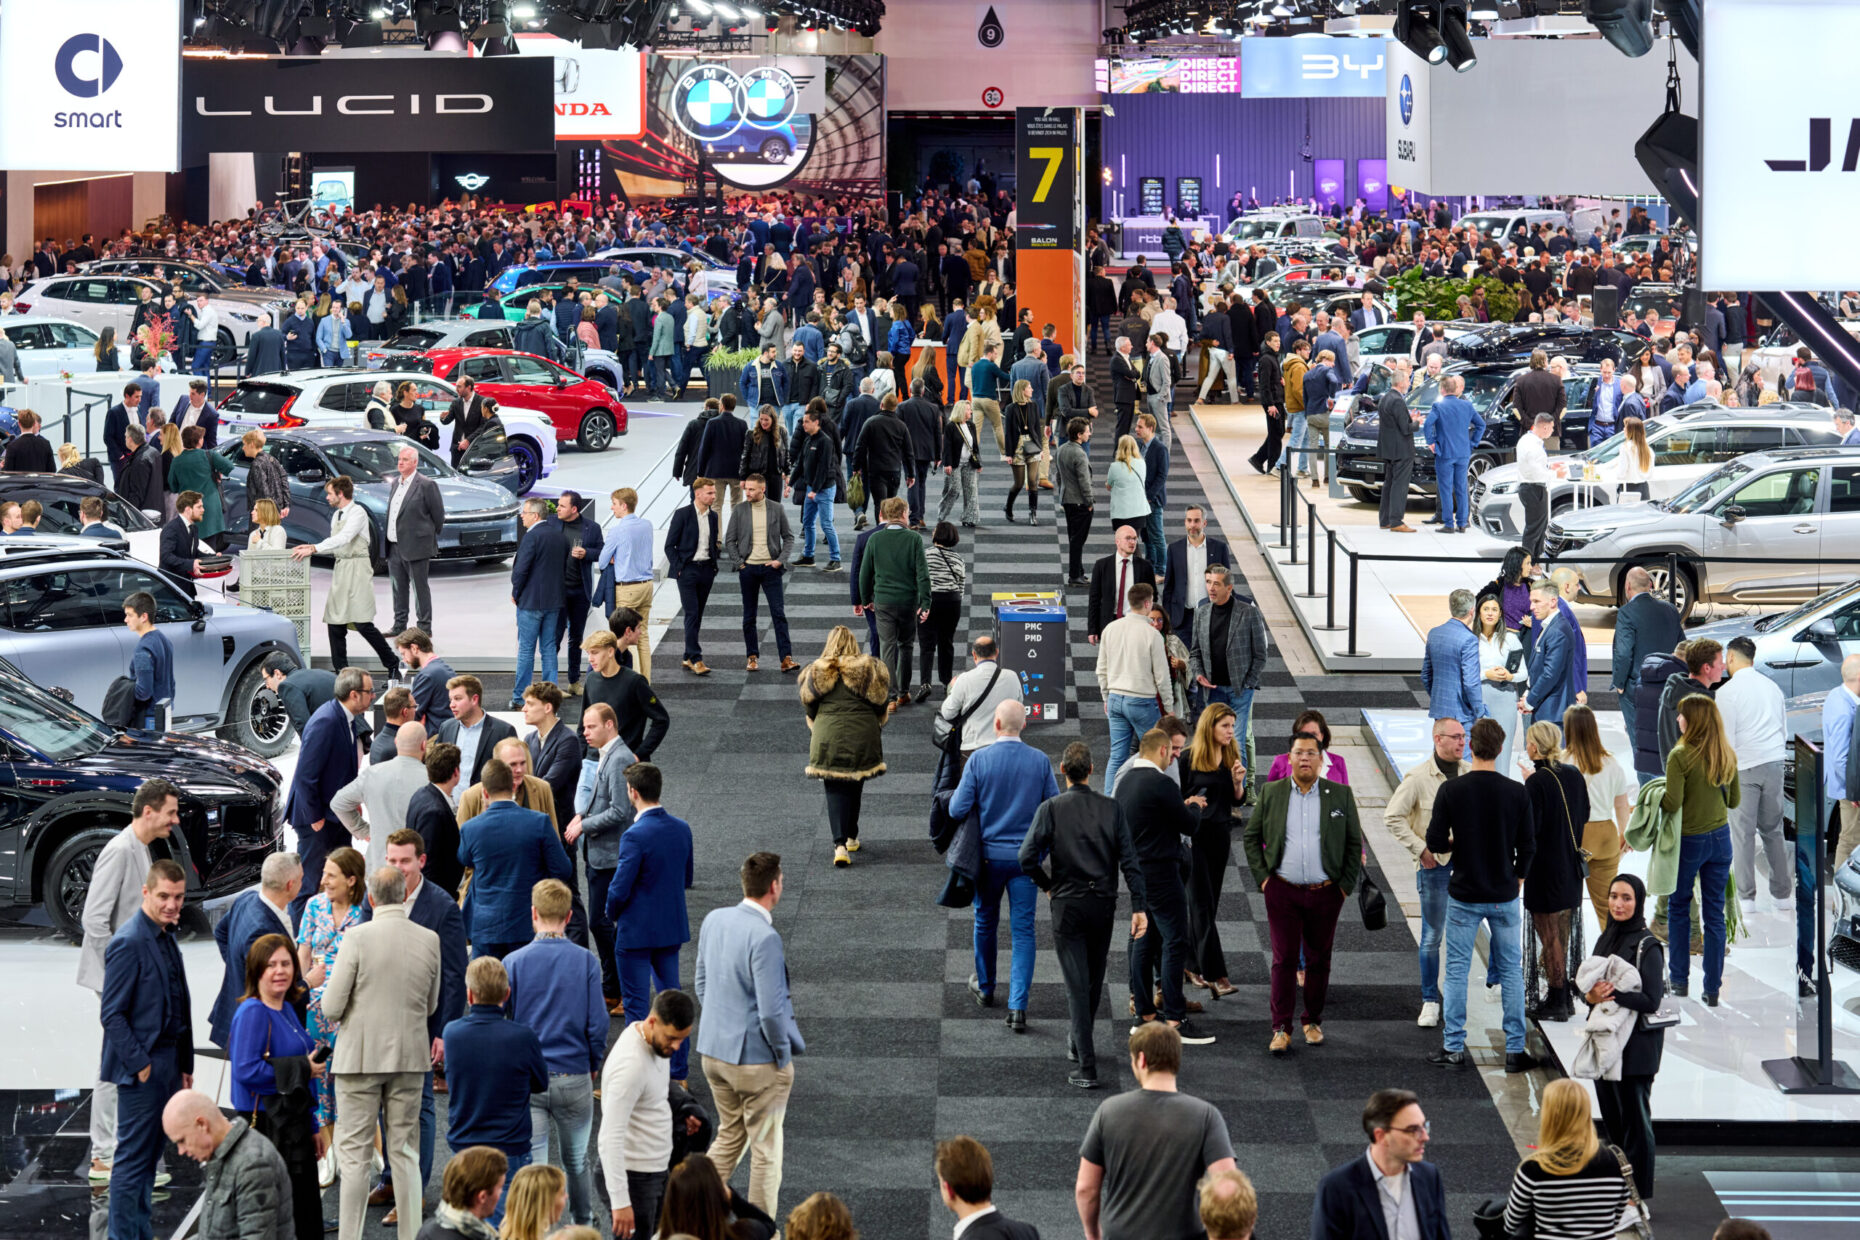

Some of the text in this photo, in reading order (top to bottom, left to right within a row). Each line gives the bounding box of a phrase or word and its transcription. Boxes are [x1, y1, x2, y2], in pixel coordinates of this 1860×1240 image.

[986, 28, 996, 40] 9
[1179, 58, 1237, 70] DIRECT
[1302, 53, 1384, 79] BY
[682, 68, 738, 91] BMW
[743, 70, 790, 88] BMW
[1179, 70, 1237, 81] DIRECT
[1179, 81, 1237, 93] DIRECT
[196, 94, 494, 115] LUCID
[554, 103, 612, 116] NDA
[54, 110, 122, 129] smart
[1029, 147, 1064, 203] 7
[1138, 234, 1162, 244] rtb
[1024, 622, 1042, 630] PMC
